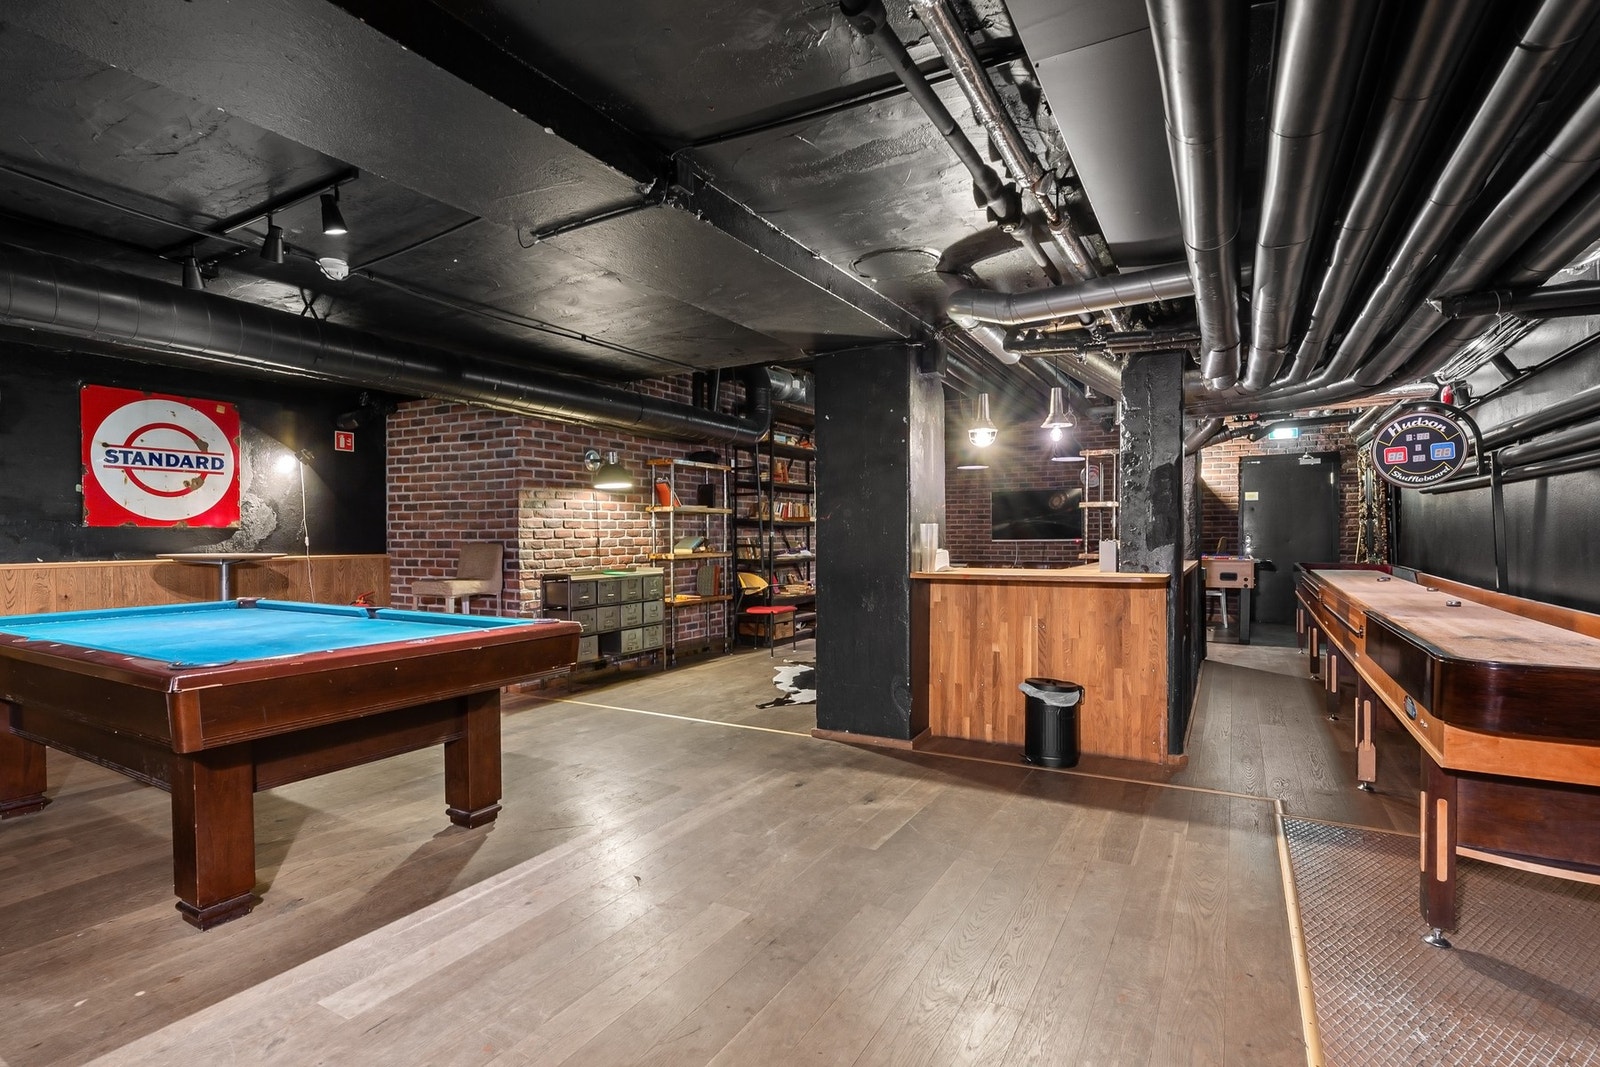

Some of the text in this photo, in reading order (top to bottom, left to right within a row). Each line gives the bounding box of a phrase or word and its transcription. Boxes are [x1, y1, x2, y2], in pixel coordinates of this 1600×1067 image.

[1388, 417, 1447, 436] Hudson
[103, 448, 225, 470] STANDARD
[1391, 466, 1450, 482] Shuffleboard
